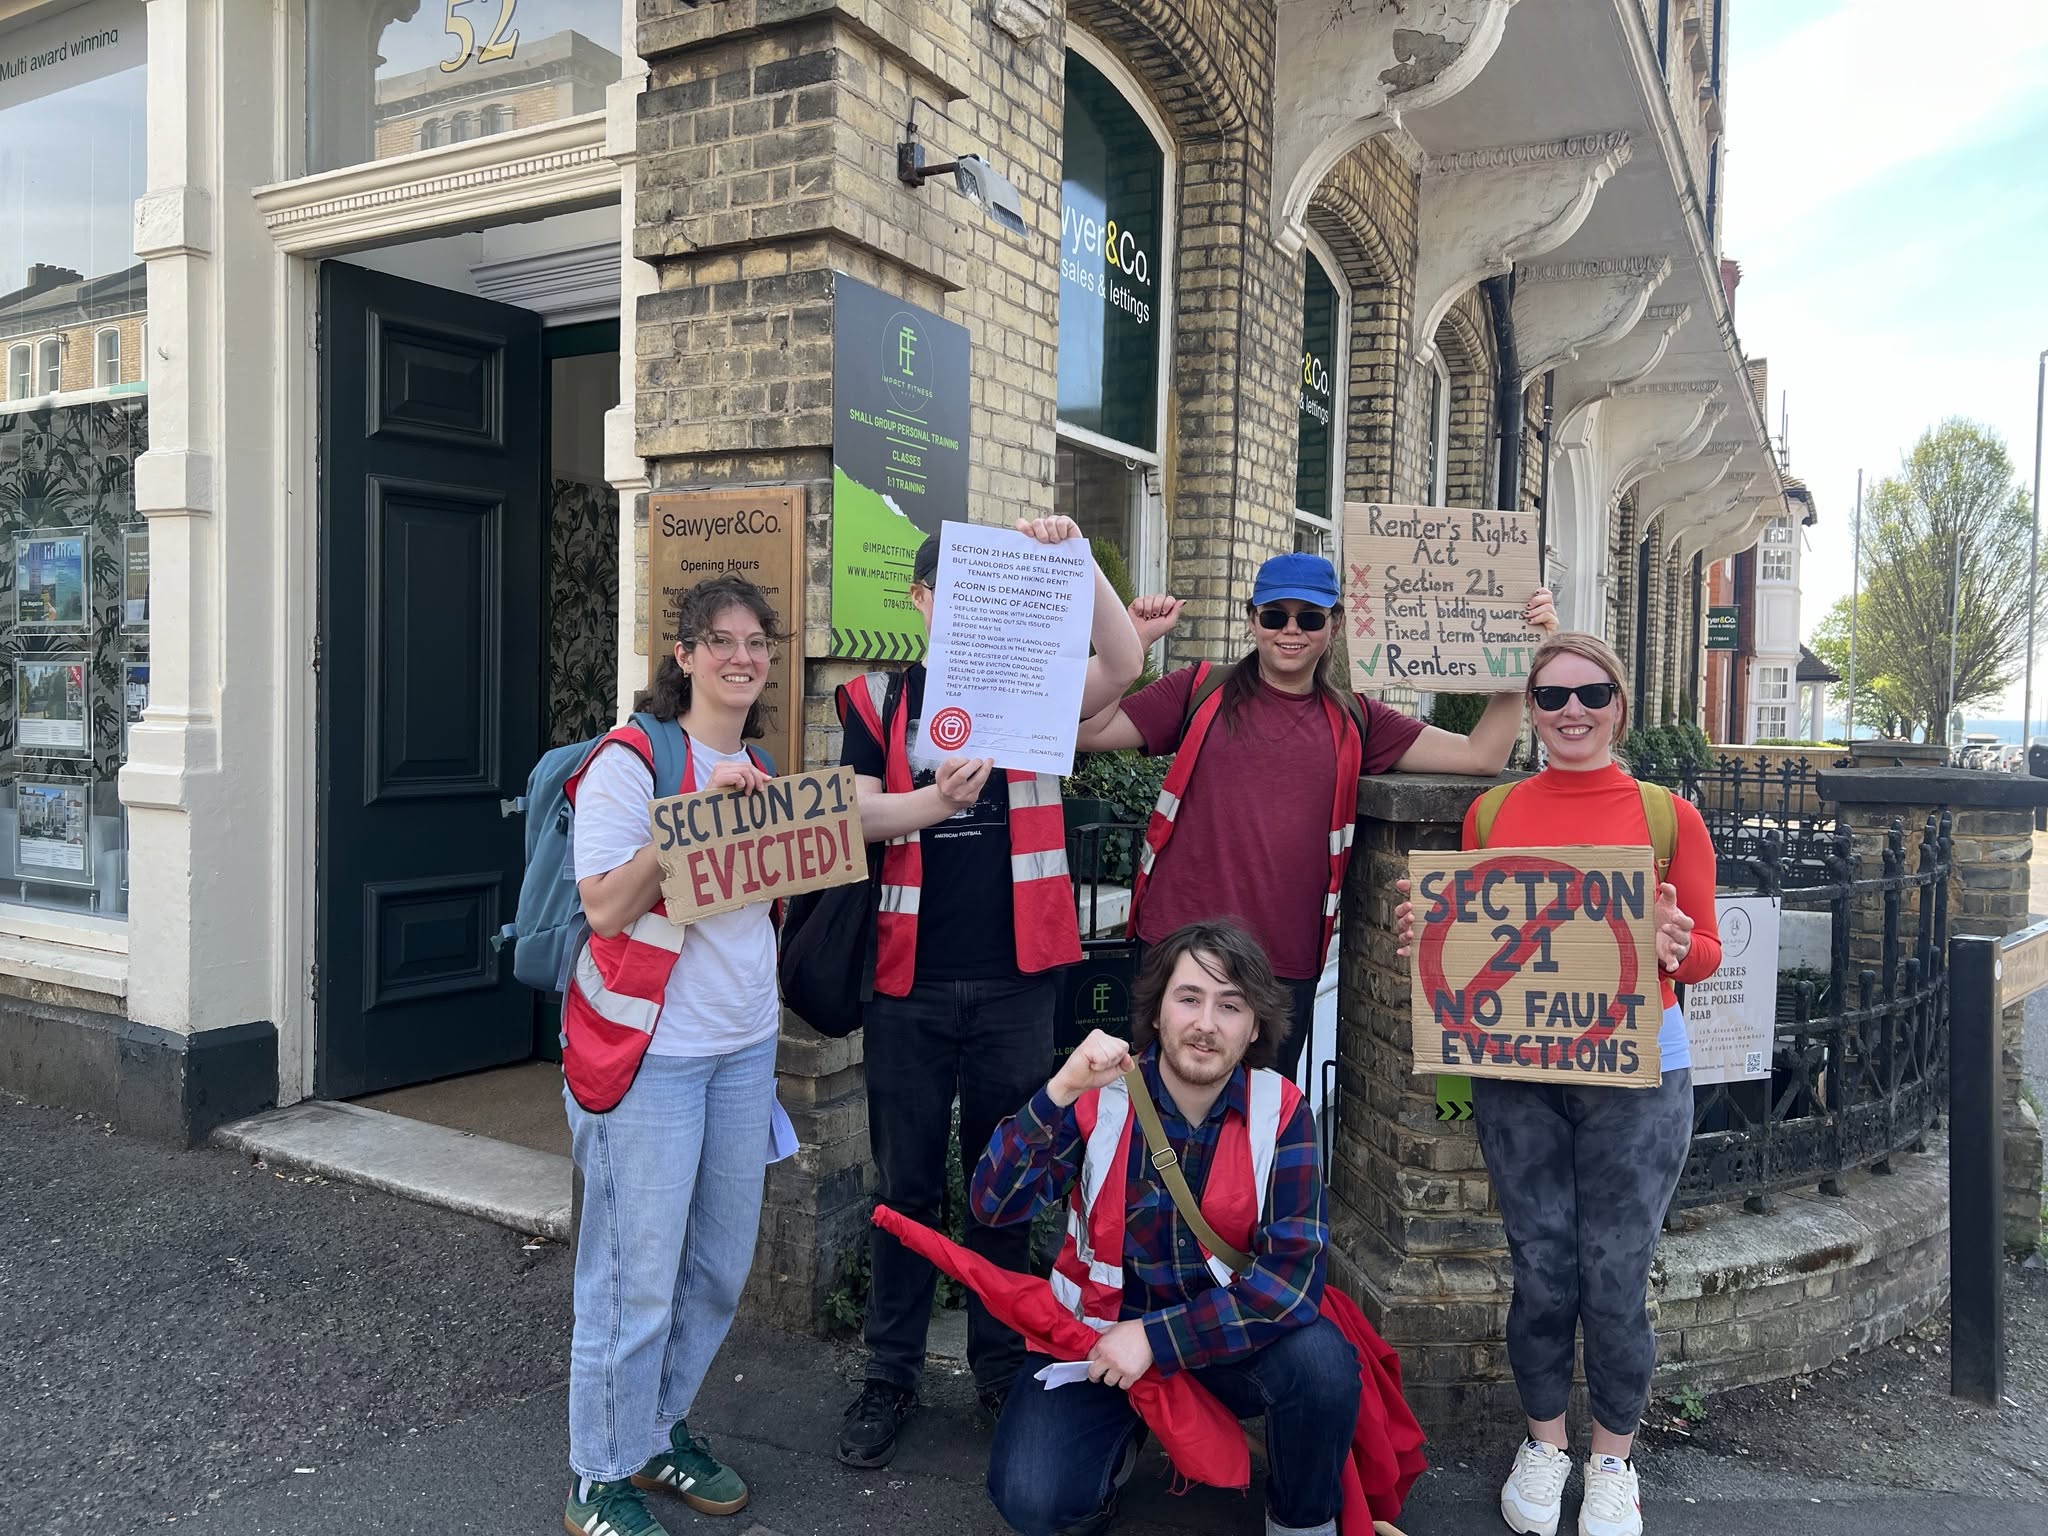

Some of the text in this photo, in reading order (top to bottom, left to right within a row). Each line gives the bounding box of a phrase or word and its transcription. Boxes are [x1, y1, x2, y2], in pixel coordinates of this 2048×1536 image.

[440, 0, 519, 73] 52
[0, 28, 119, 81] Multi award winning
[1061, 258, 1150, 324] sales & lettings
[881, 374, 905, 389] IMPACT
[907, 383, 933, 398] FITNESS
[849, 408, 960, 451] SMALL GROUP PERSONAL TRAINING
[892, 449, 921, 467] CLASSES
[887, 476, 926, 495] 1:1 TRAINING
[662, 510, 781, 542] Sawyer&Co.
[1368, 505, 1527, 557] Renter's Rights
[863, 542, 916, 560] @IMPACTFITNE
[951, 544, 989, 556] SECTION
[1001, 551, 1021, 560] HAS
[1023, 553, 1046, 562] BEEN
[1048, 555, 1085, 566] BANNED!
[1412, 539, 1459, 566] Act
[680, 558, 760, 573] Opening Hours
[847, 566, 913, 584] WWW.IMPACTFITNE
[968, 560, 1014, 570] LANDLORDS
[1032, 566, 1050, 574] STILL
[1051, 568, 1084, 578] EVICTING
[967, 569, 1001, 579] TENANTS
[1021, 575, 1045, 583] HIKING
[1046, 578, 1069, 587] RENT!
[1384, 565, 1504, 597] Section 21s
[953, 581, 1073, 601] ACORN IS DEMANDING THE
[884, 598, 916, 611] 07841373
[952, 592, 1069, 613] FOLLOWING OF AGENCIES:
[1384, 592, 1525, 631] Rent bidding wars
[953, 622, 977, 630] BEFORE
[970, 615, 1003, 624] CARRYING
[1028, 621, 1051, 629] ISSUED
[1025, 612, 1064, 622] LANDLORDS
[1709, 616, 1736, 625] yer&Co.
[952, 631, 976, 639] REFUSE
[1022, 639, 1060, 648] LANDLORDS
[1384, 620, 1541, 644] Fixed term tenancies
[972, 642, 1007, 650] LOOPHOLES
[974, 652, 1002, 660] REGISTER
[1010, 656, 1048, 665] LANDLORDS
[1011, 664, 1043, 672] GROUNDS
[1386, 644, 1477, 678] Renters
[995, 670, 1019, 678] MOVING
[1031, 733, 1058, 742] (AGENCY)
[1028, 748, 1064, 758] (SIGNATURE)
[654, 782, 794, 851] SECTION
[687, 819, 852, 907] EVICTED!
[1420, 870, 1645, 923] SECTION
[1490, 924, 1559, 973] 21
[1691, 980, 1743, 993] PEDICURES
[1434, 989, 1646, 1030] NO FAULT
[1690, 994, 1745, 1007] GEL POLISH
[1690, 1010, 1712, 1021] BIAB
[1441, 1030, 1640, 1074] EVICTIONS
